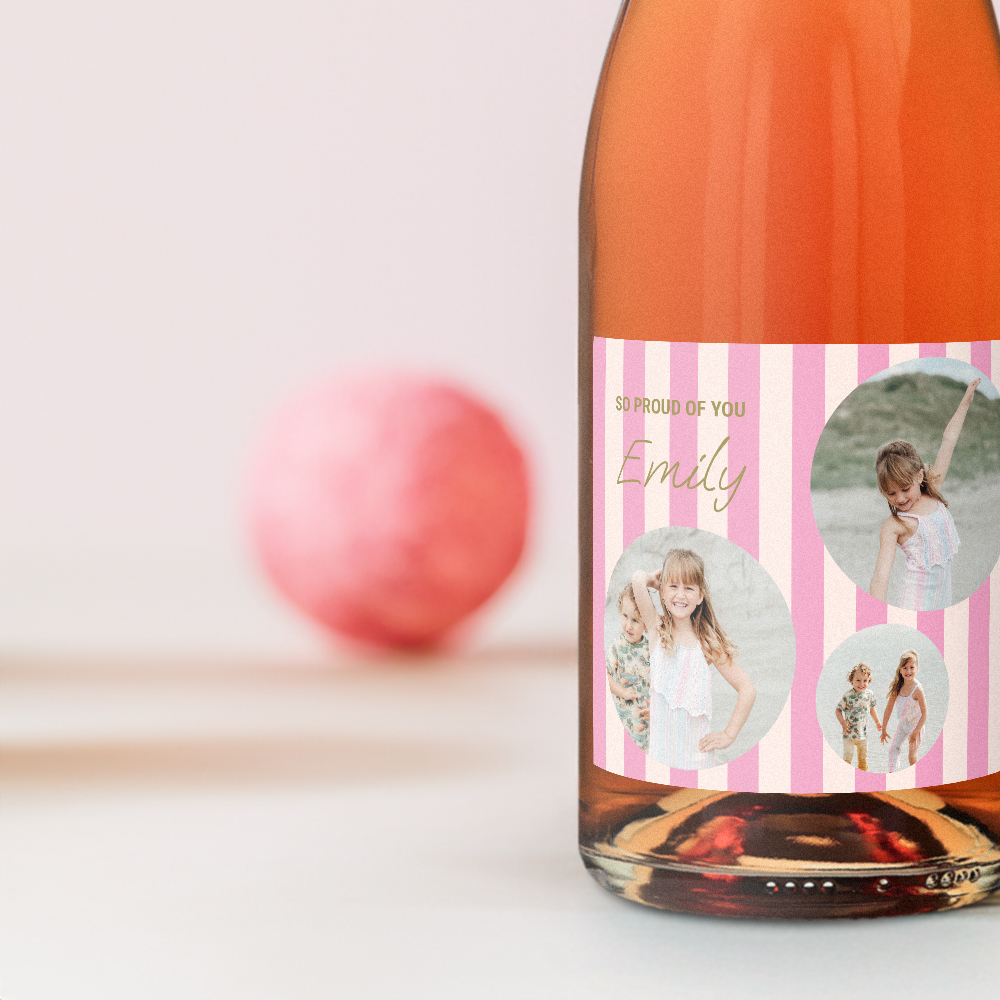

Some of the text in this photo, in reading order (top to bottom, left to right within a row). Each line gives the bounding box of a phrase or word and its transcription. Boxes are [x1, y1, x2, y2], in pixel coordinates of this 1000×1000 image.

[615, 395, 746, 418] SO PROUD OF YOU
[616, 435, 747, 513] Emily
